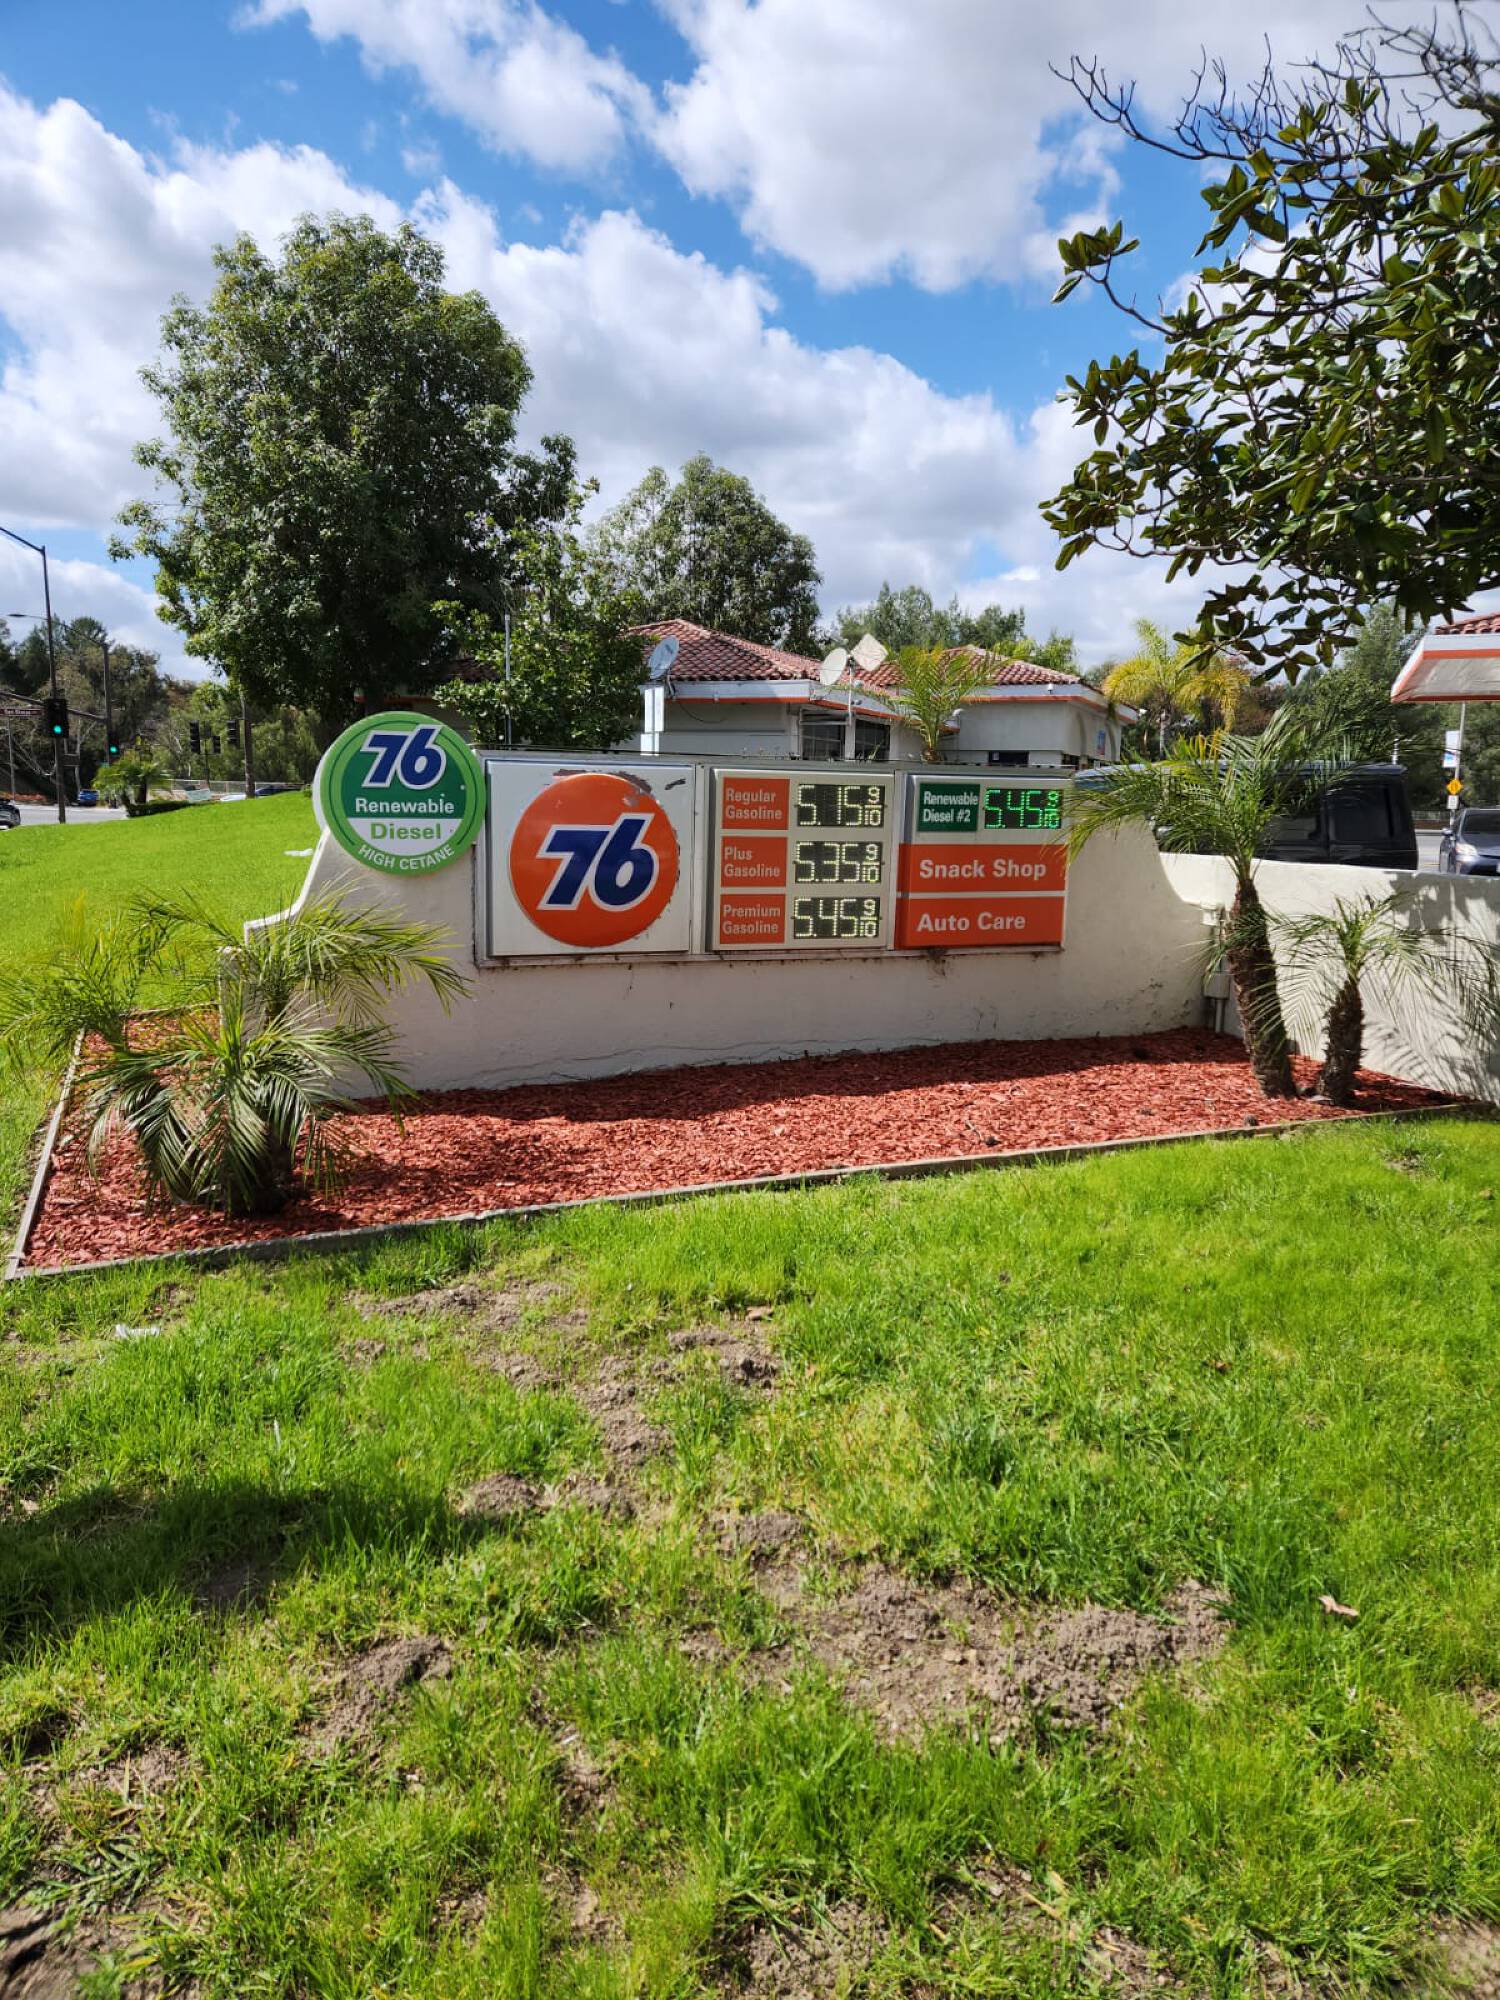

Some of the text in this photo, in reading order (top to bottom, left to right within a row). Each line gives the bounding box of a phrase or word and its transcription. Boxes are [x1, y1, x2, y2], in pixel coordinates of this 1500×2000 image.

[360, 724, 447, 789] 76
[725, 788, 776, 805] Regular
[923, 791, 979, 806] Renewable
[355, 797, 455, 814] Renewable
[725, 805, 782, 820] Gasoline
[922, 808, 971, 823] Diesel #2
[370, 823, 441, 840] Diesel
[358, 844, 455, 870] HIGH CETANE
[536, 812, 659, 912] 76
[724, 846, 753, 861] Plus
[723, 863, 781, 878] Gasoline
[919, 859, 1047, 881] Snack Shop
[723, 904, 781, 918] Premium
[722, 921, 779, 935] Gasoline
[916, 912, 1026, 932] Auto Care
